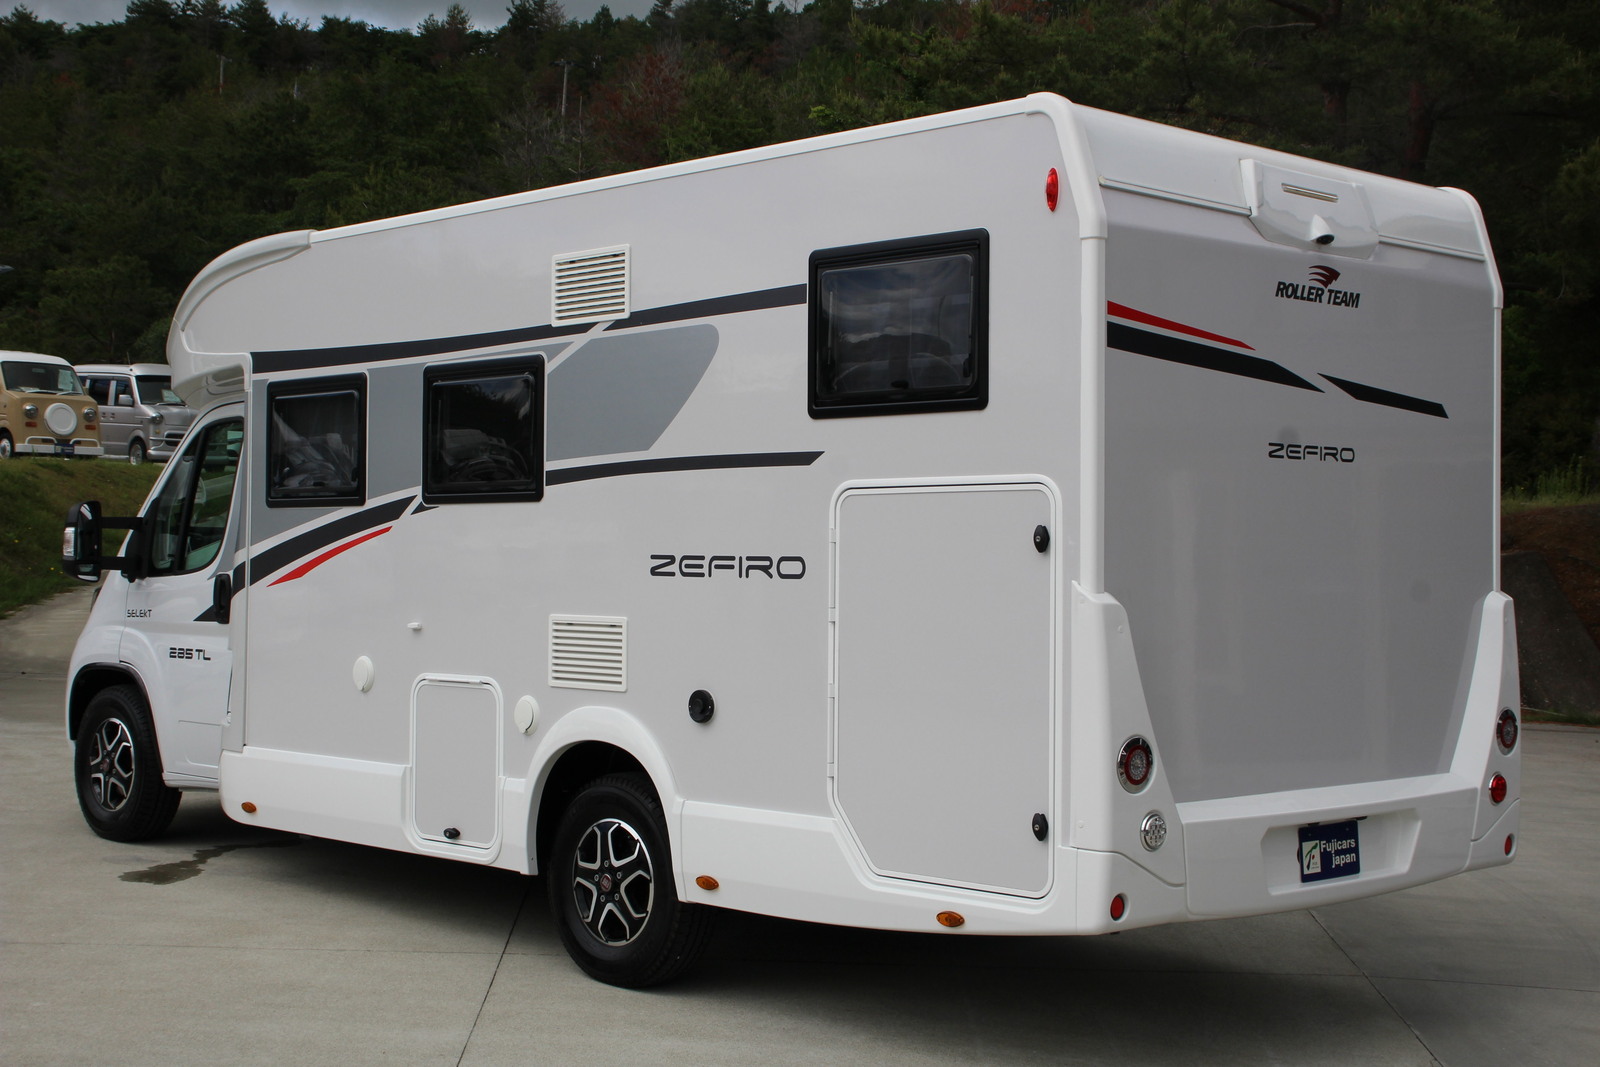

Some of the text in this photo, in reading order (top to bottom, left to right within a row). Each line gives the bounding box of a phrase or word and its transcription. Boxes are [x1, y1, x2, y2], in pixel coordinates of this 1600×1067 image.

[1275, 281, 1360, 308] ROLLER TEAM
[1268, 442, 1355, 463] ZEFIRO
[650, 554, 806, 579] ZEFIRO
[195, 648, 211, 661] TL
[1320, 839, 1356, 853] Fujicars
[1332, 853, 1356, 868] japan
